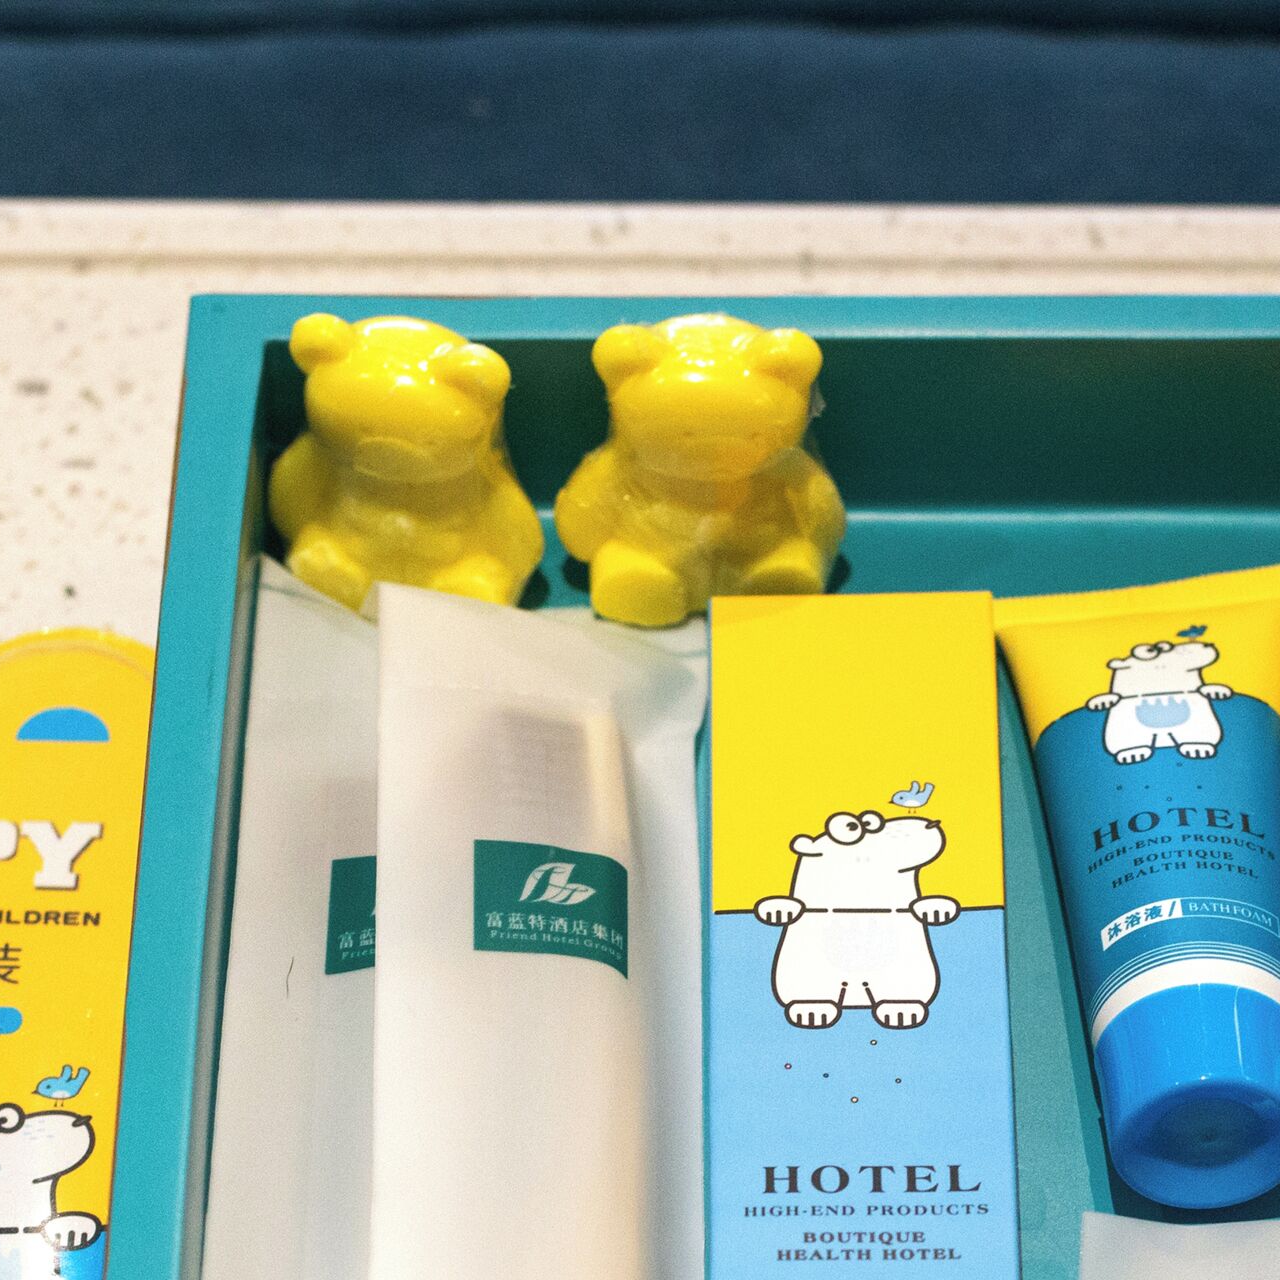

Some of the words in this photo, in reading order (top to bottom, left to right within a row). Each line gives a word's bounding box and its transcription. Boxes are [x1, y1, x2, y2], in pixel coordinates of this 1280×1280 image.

[1092, 807, 1265, 851] HOTEL
[1087, 835, 1172, 874] HIGH-END
[1182, 834, 1275, 861] PRODUCTS
[1133, 849, 1234, 867] BOUTIQUE
[1112, 861, 1186, 889] HEALTH
[1196, 861, 1259, 880] HOTEL
[485, 911, 623, 946] 富蓝特酒店集团
[490, 929, 537, 941] Friend
[542, 931, 580, 945] Hotel
[762, 1164, 981, 1194] HOTEL
[744, 1205, 855, 1217] HIGH-END
[866, 1204, 989, 1216] PRODUCTS
[803, 1232, 926, 1245] BOUTIQUE
[777, 1250, 870, 1262] HEALTH
[883, 1248, 962, 1261] HOTEL
